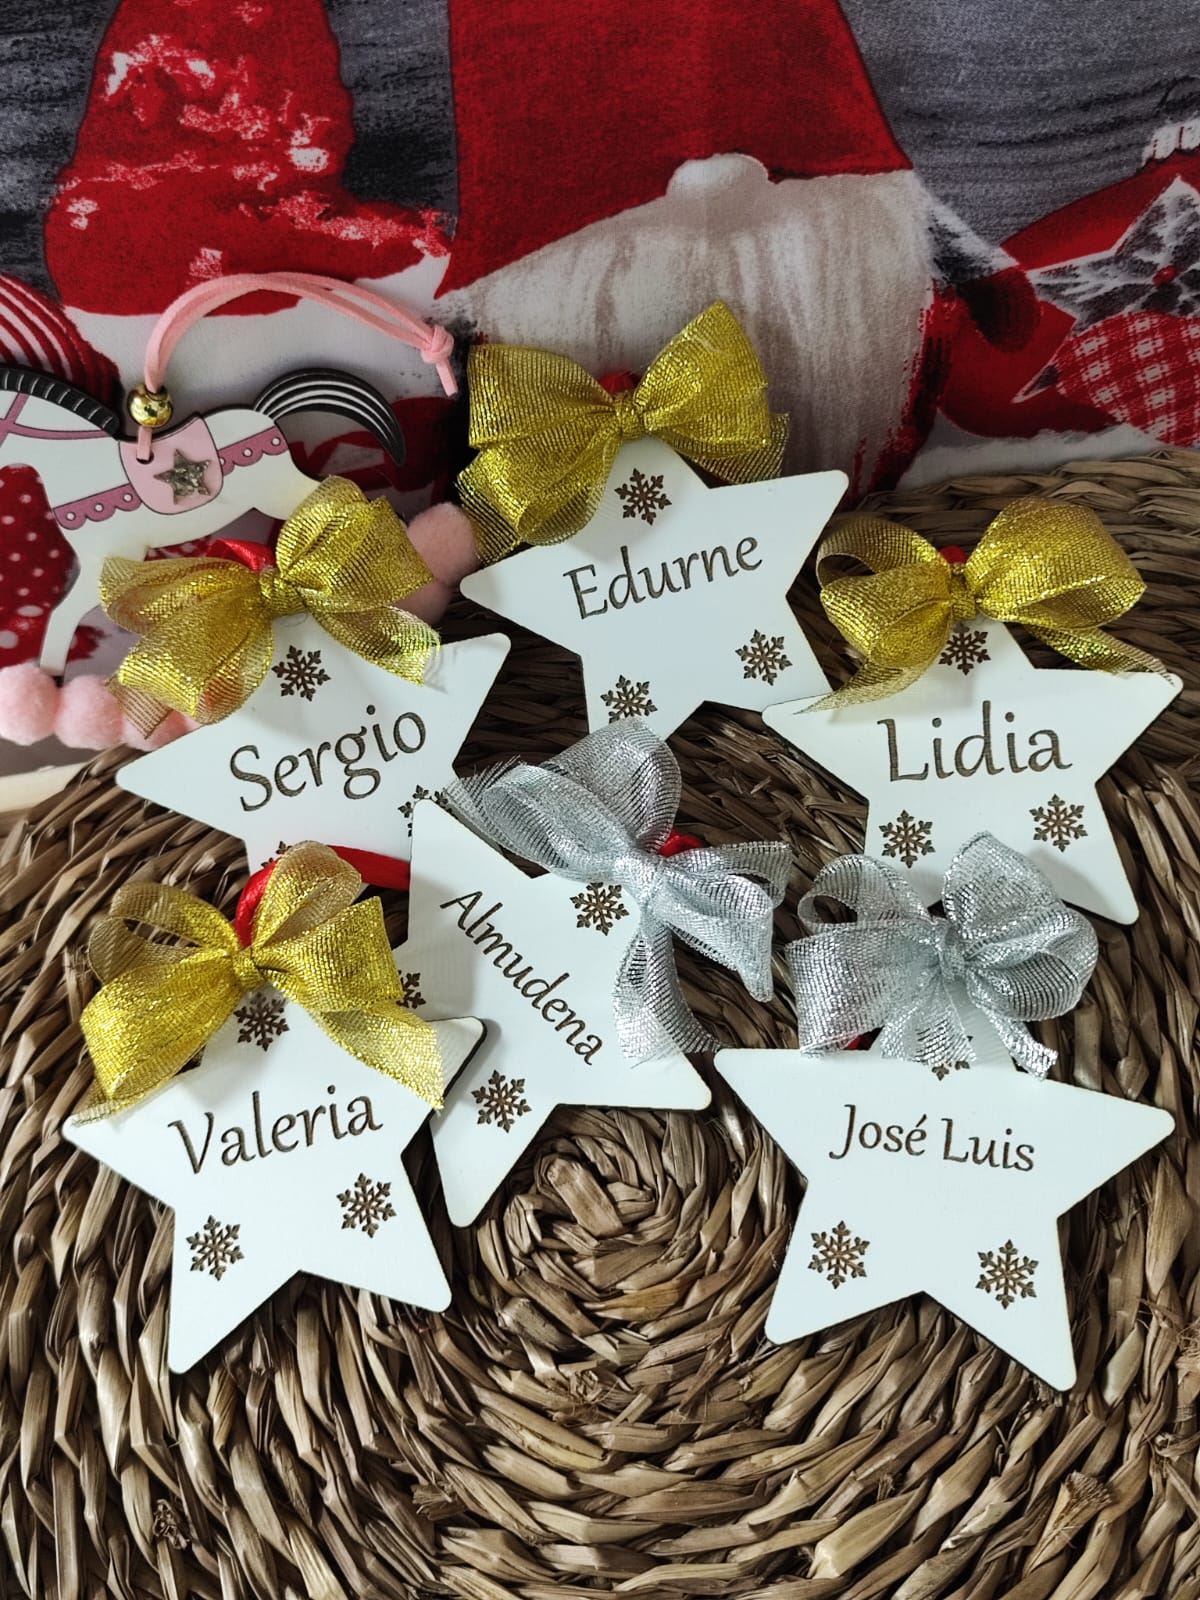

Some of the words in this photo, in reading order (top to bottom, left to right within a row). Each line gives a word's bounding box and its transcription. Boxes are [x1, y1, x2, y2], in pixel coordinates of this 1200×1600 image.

[563, 536, 763, 621] Edurne
[229, 704, 427, 813] Sergio
[877, 699, 1074, 783] Lidia
[439, 890, 604, 1067] Almudena
[166, 1084, 384, 1175] Valeria
[828, 1103, 928, 1161] José
[940, 1117, 1036, 1173] Luis
